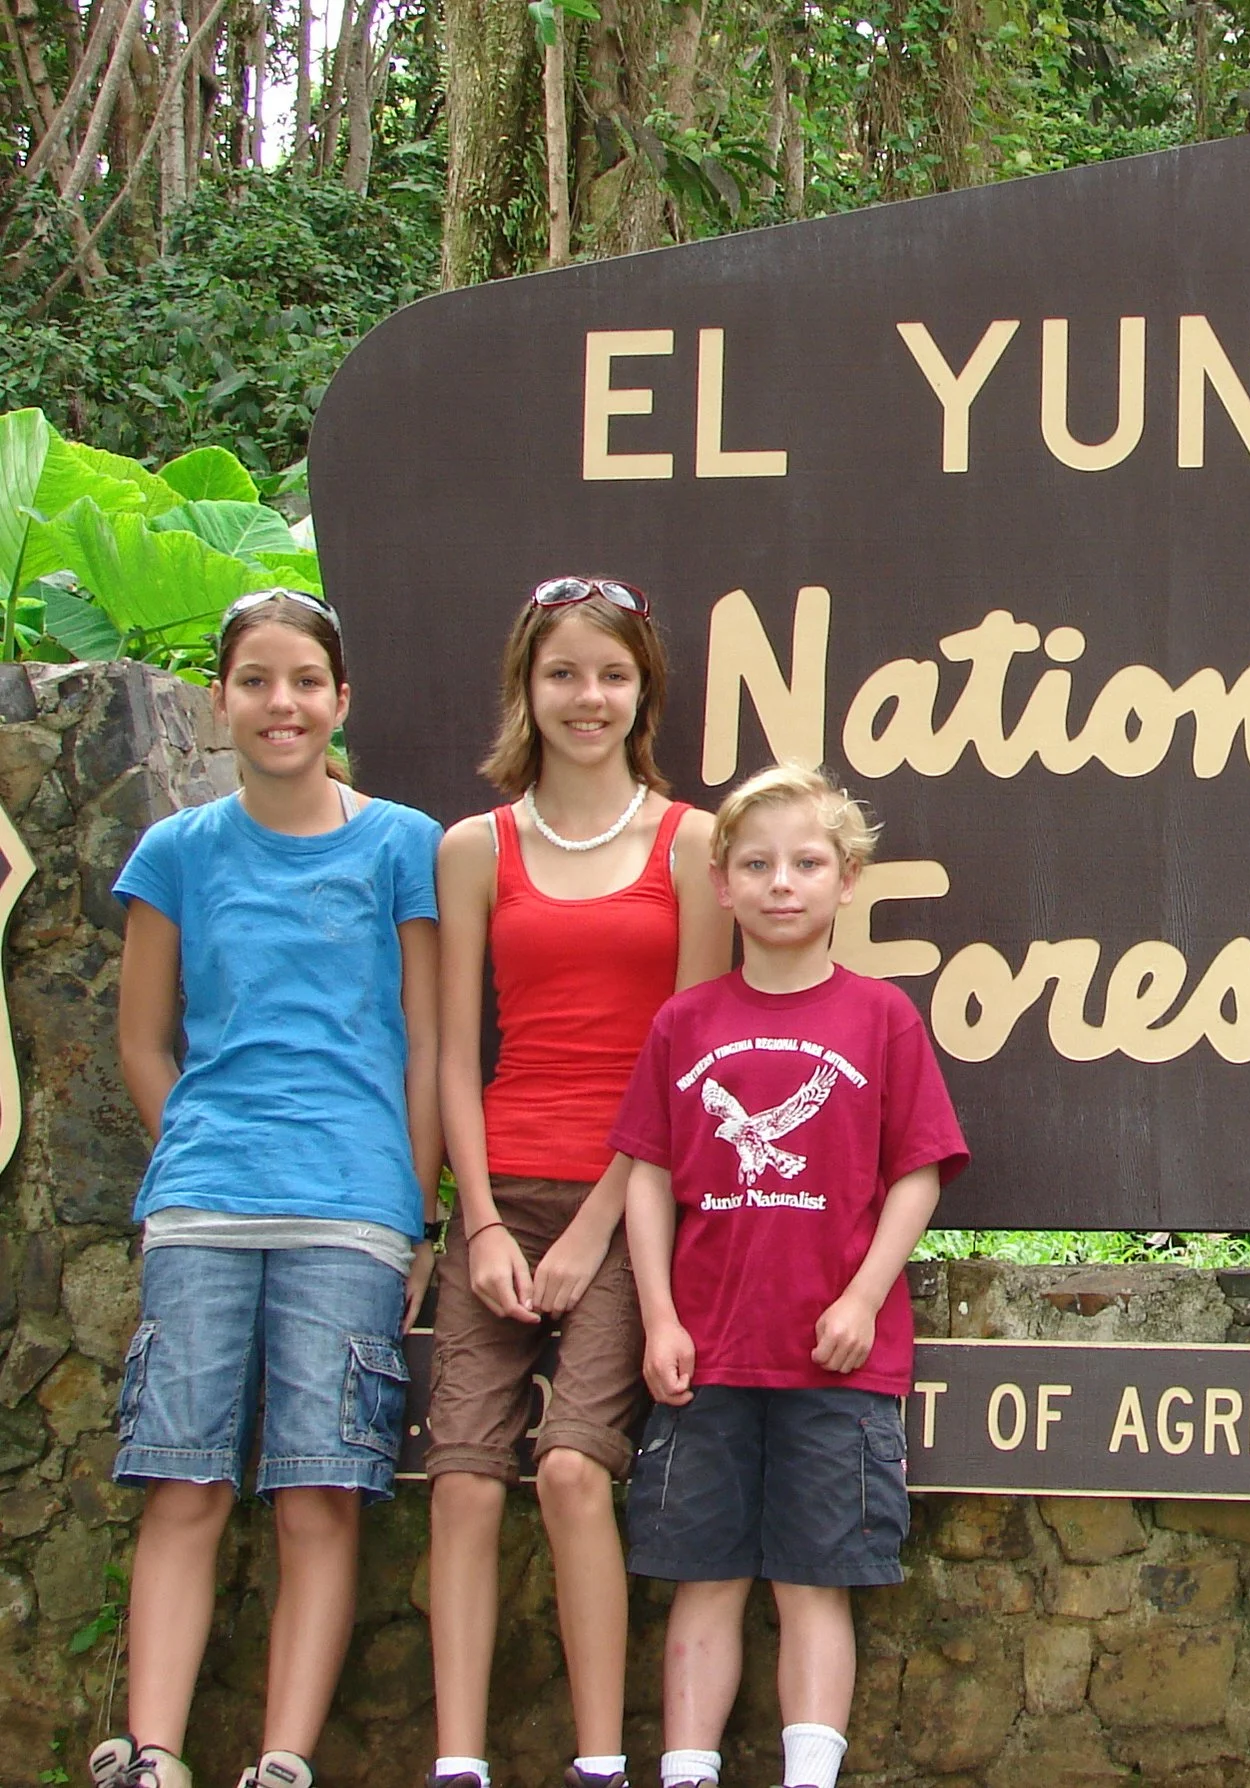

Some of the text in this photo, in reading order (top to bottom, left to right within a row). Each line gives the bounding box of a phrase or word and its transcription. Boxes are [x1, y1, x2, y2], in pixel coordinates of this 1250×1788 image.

[583, 328, 788, 481] EL
[713, 1038, 755, 1060] VIRGINIA
[754, 1037, 799, 1051] REGIONAL
[799, 1040, 825, 1058] PARK
[821, 1049, 869, 1089] AUTHORITY
[745, 1188, 828, 1210] Naturalist
[987, 1383, 1073, 1452] OF
